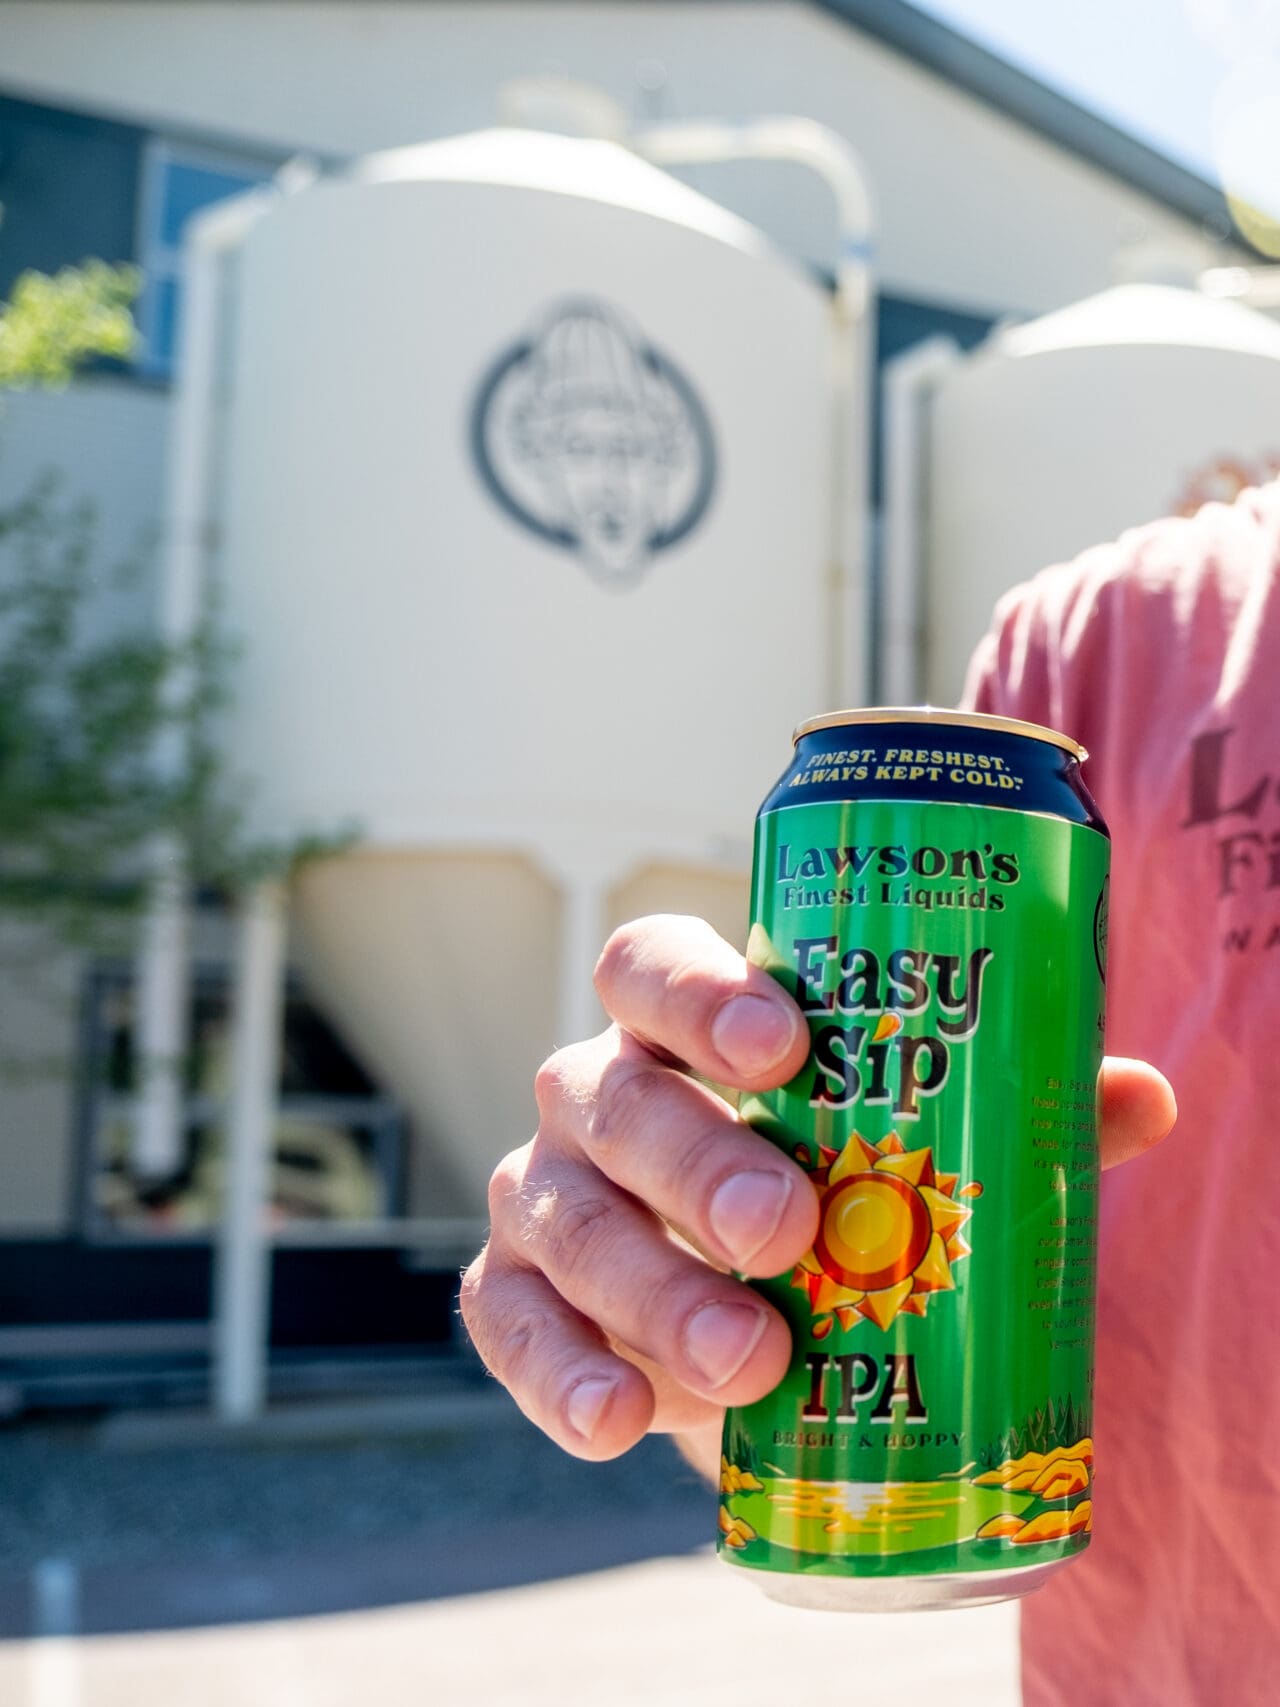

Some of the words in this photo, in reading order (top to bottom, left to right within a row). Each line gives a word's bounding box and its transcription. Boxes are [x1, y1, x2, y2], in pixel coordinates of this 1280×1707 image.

[789, 767, 868, 788] ALWAYS
[875, 767, 943, 782] KEPT
[806, 749, 877, 768] FINEST.
[884, 748, 1011, 772] FRESHEST.
[777, 843, 1020, 883] Lawson's
[783, 882, 870, 911] Finest
[880, 882, 1006, 913] Liquids
[792, 935, 994, 1041] Easy
[809, 1012, 950, 1121] Sip
[801, 1352, 928, 1424] IPA
[773, 1431, 849, 1449] BRIGHT
[859, 1433, 873, 1448] &
[883, 1432, 966, 1449] HOPPY
